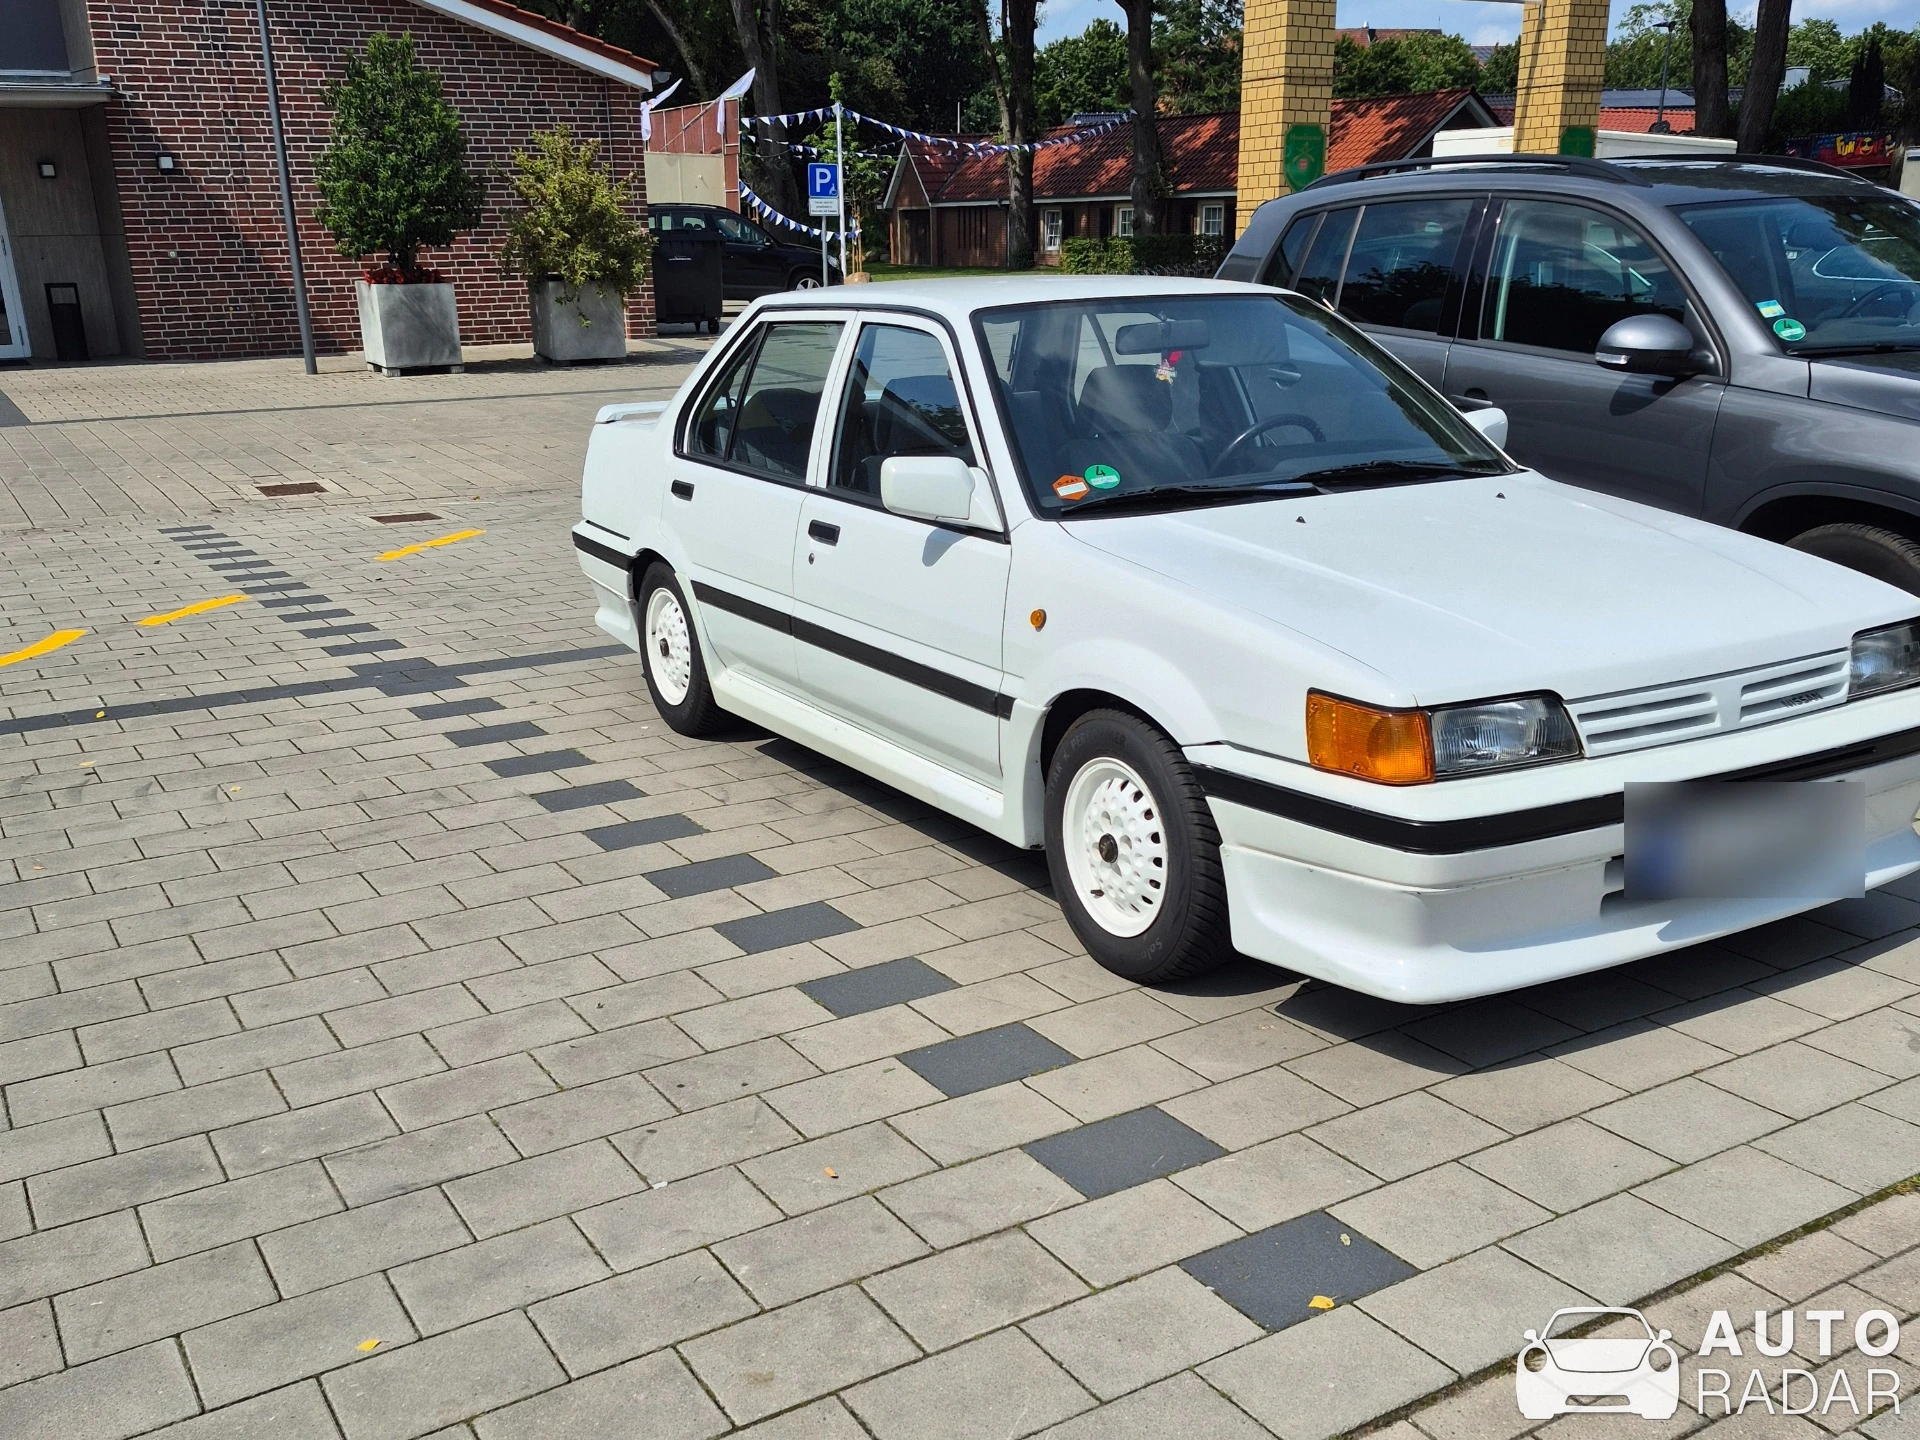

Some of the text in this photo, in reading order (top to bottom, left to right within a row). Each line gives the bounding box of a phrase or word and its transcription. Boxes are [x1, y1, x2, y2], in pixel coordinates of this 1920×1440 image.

[816, 168, 831, 192] P
[1783, 320, 1793, 329] 4
[1096, 466, 1106, 476] 4
[1781, 693, 1823, 707] NISSAN
